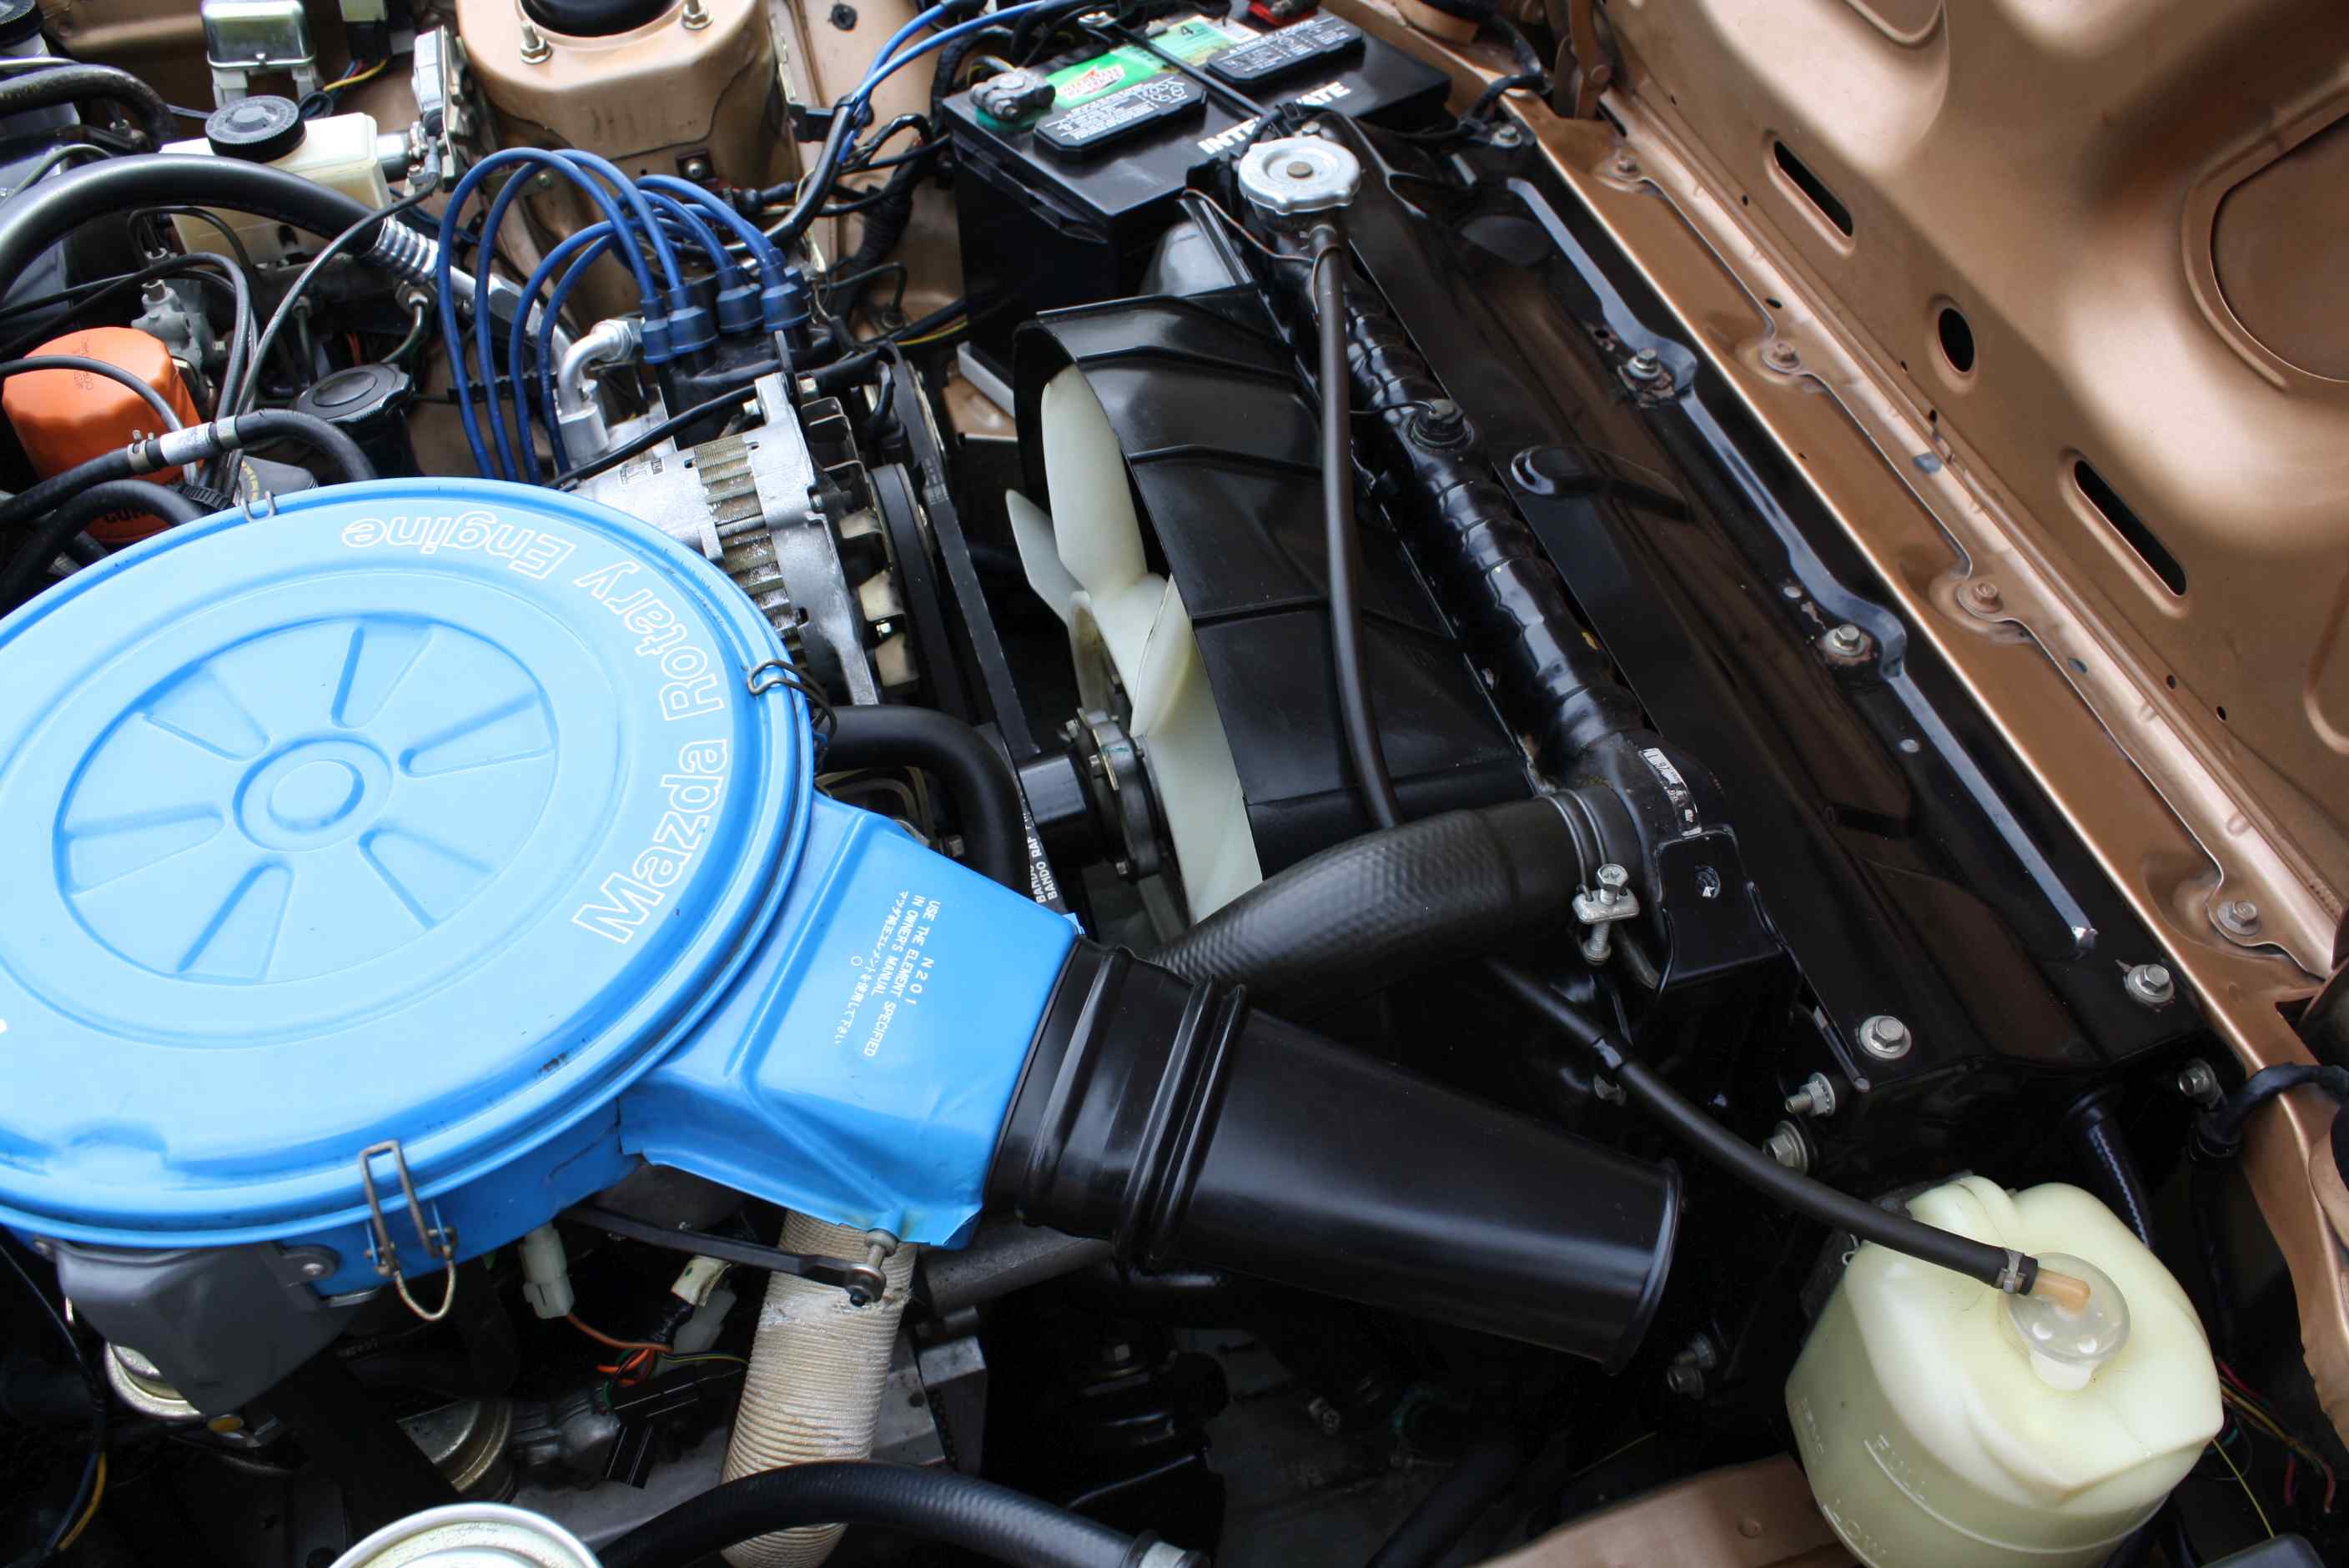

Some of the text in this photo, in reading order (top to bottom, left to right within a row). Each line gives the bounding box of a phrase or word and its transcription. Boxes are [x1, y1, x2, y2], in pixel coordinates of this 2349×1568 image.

[341, 510, 727, 944] Mazda Rotary Engine
[1036, 861, 1058, 901] BANDO
[863, 900, 941, 1057] USE THE ELEMENT SPECIFIED
[871, 894, 926, 996] IN OWNER'S MANUAL
[1874, 1434, 1928, 1501] FULL
